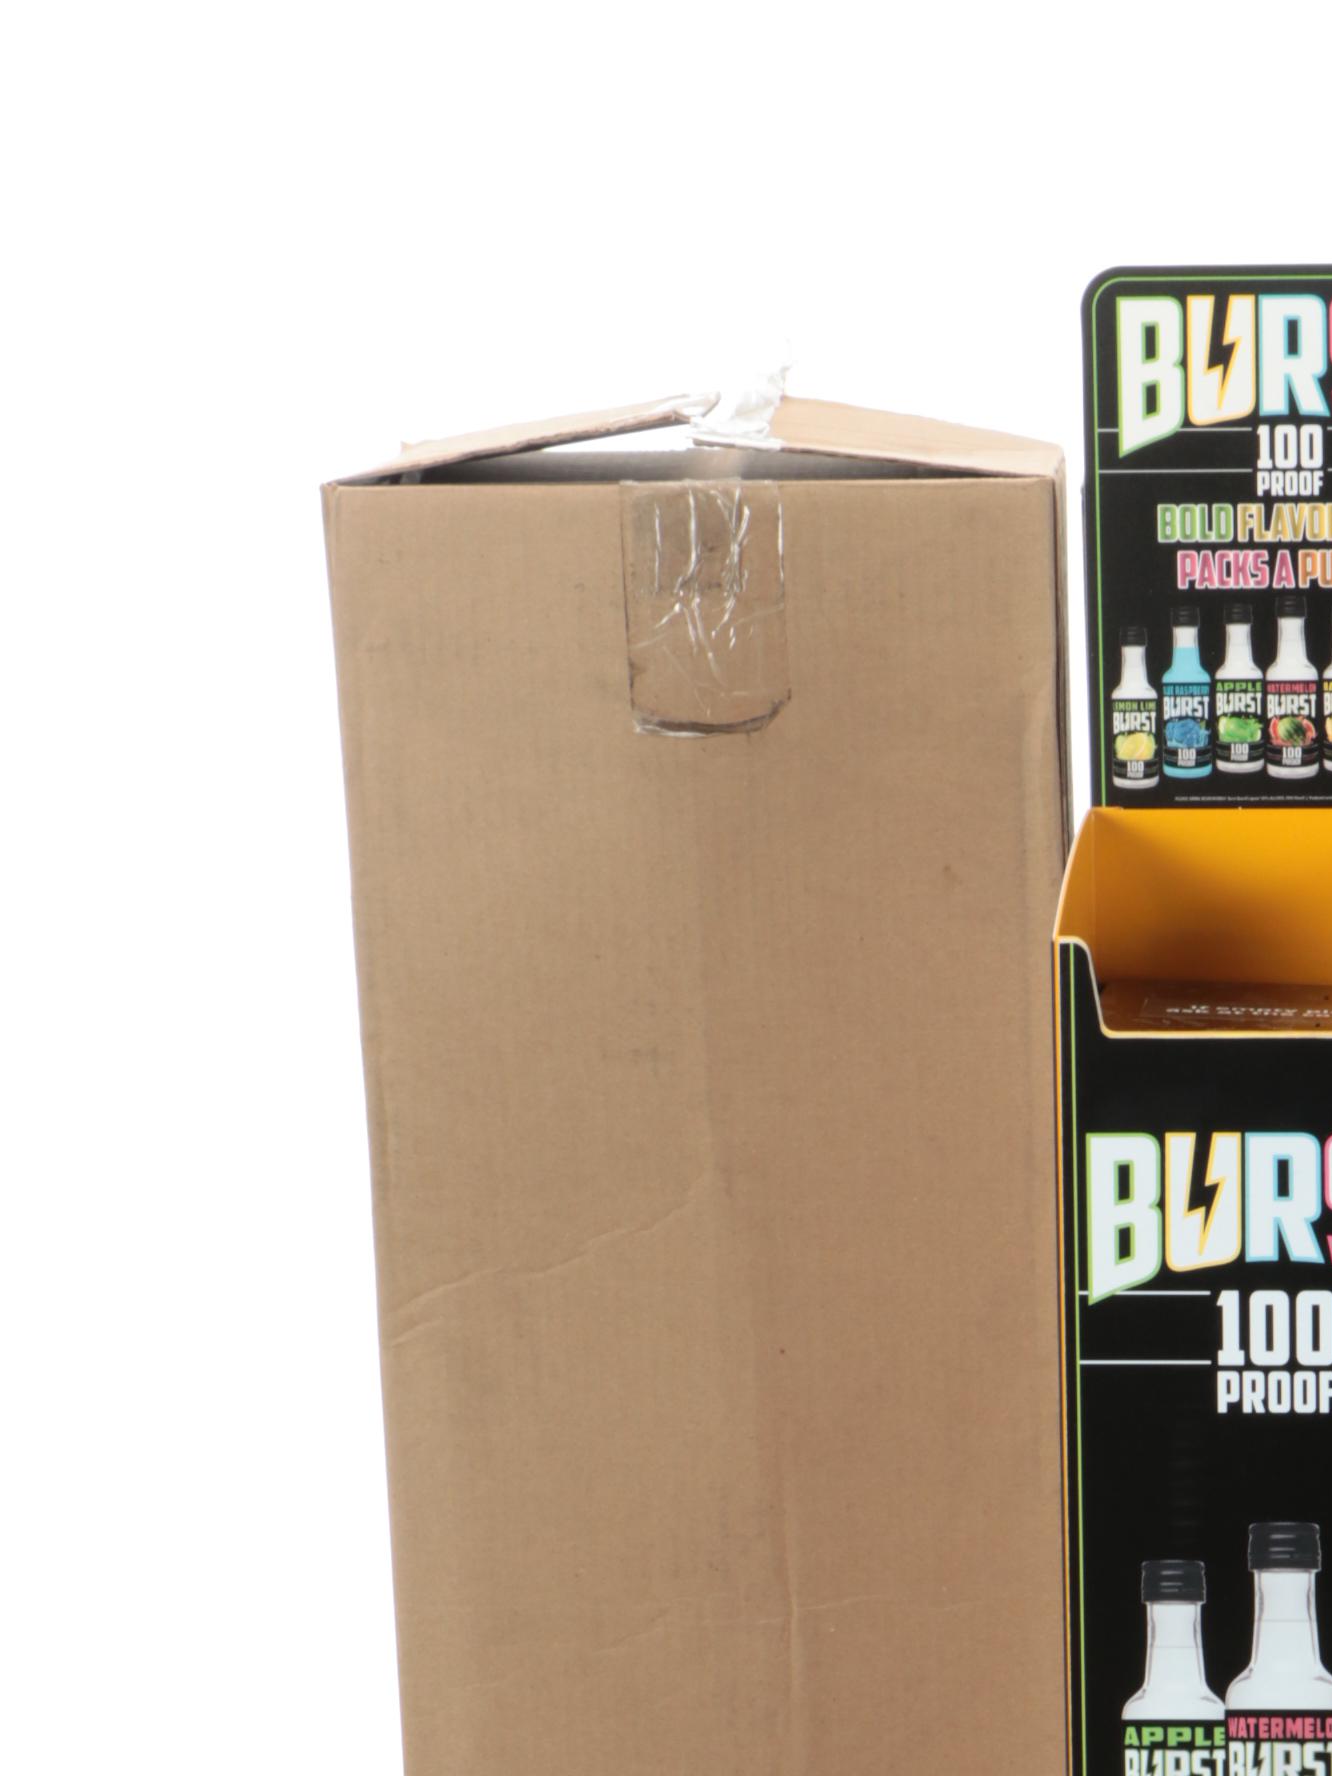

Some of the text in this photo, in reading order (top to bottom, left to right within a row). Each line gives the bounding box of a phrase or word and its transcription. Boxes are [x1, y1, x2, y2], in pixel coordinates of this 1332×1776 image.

[1256, 424, 1324, 469] 100
[1256, 470, 1325, 497] PROOF
[1157, 503, 1234, 543] BOLD
[1177, 550, 1270, 589] PACKS
[1272, 550, 1296, 589] A
[1216, 681, 1262, 691] APPLE
[1163, 696, 1209, 720] BURST
[1216, 692, 1262, 716] BURST
[1267, 694, 1317, 719] BURST
[1113, 711, 1156, 735] BURST
[1177, 748, 1196, 760] 100
[1231, 743, 1249, 753] 100
[1282, 747, 1301, 758] 100
[1127, 760, 1144, 772] 100
[1124, 1726, 1226, 1747] APPLE
